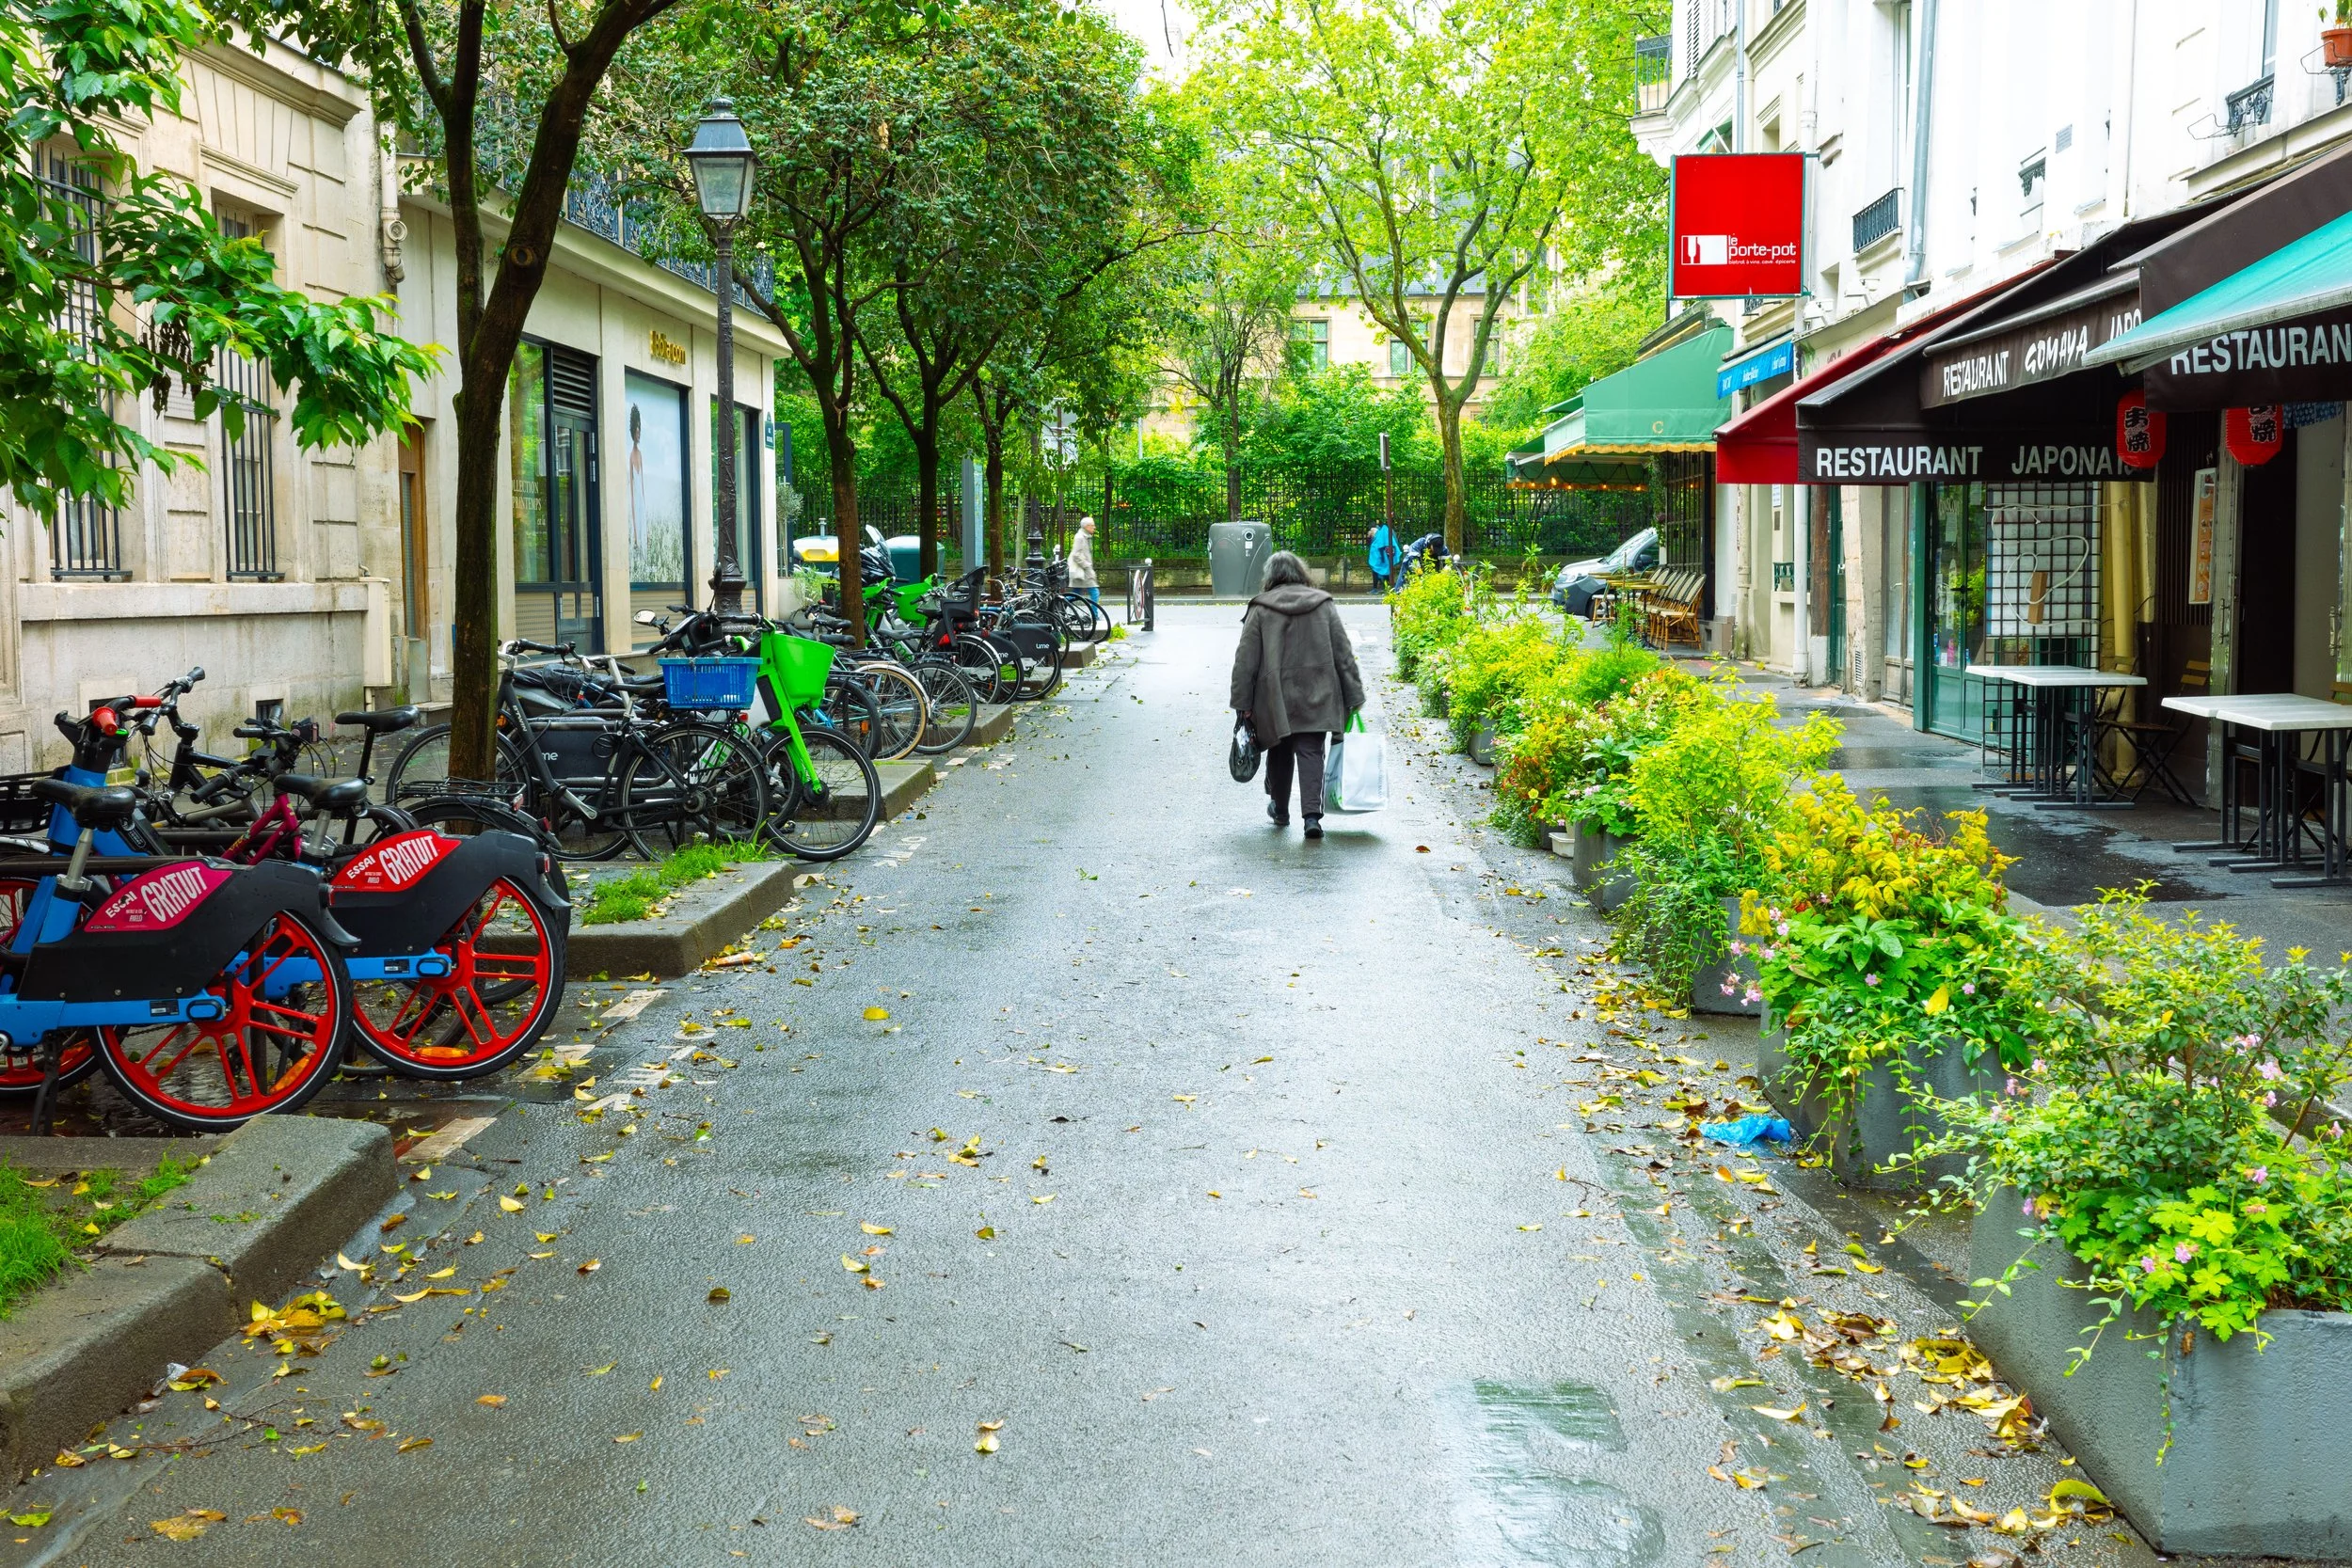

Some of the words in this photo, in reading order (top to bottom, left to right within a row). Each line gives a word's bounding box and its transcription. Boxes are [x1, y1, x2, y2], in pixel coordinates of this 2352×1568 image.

[1728, 235, 1738, 245] le
[1728, 242, 1796, 260] porte-pot
[1944, 351, 2009, 398] RESTAURANT
[2025, 325, 2088, 374] GOMAYA
[2171, 324, 2352, 375] RESTAURAN
[1817, 446, 1983, 477] RESTAURANT
[541, 752, 559, 761] me
[346, 855, 376, 879] ESSAI
[378, 835, 438, 885] GRATUIT
[141, 867, 207, 922] GRATUIT
